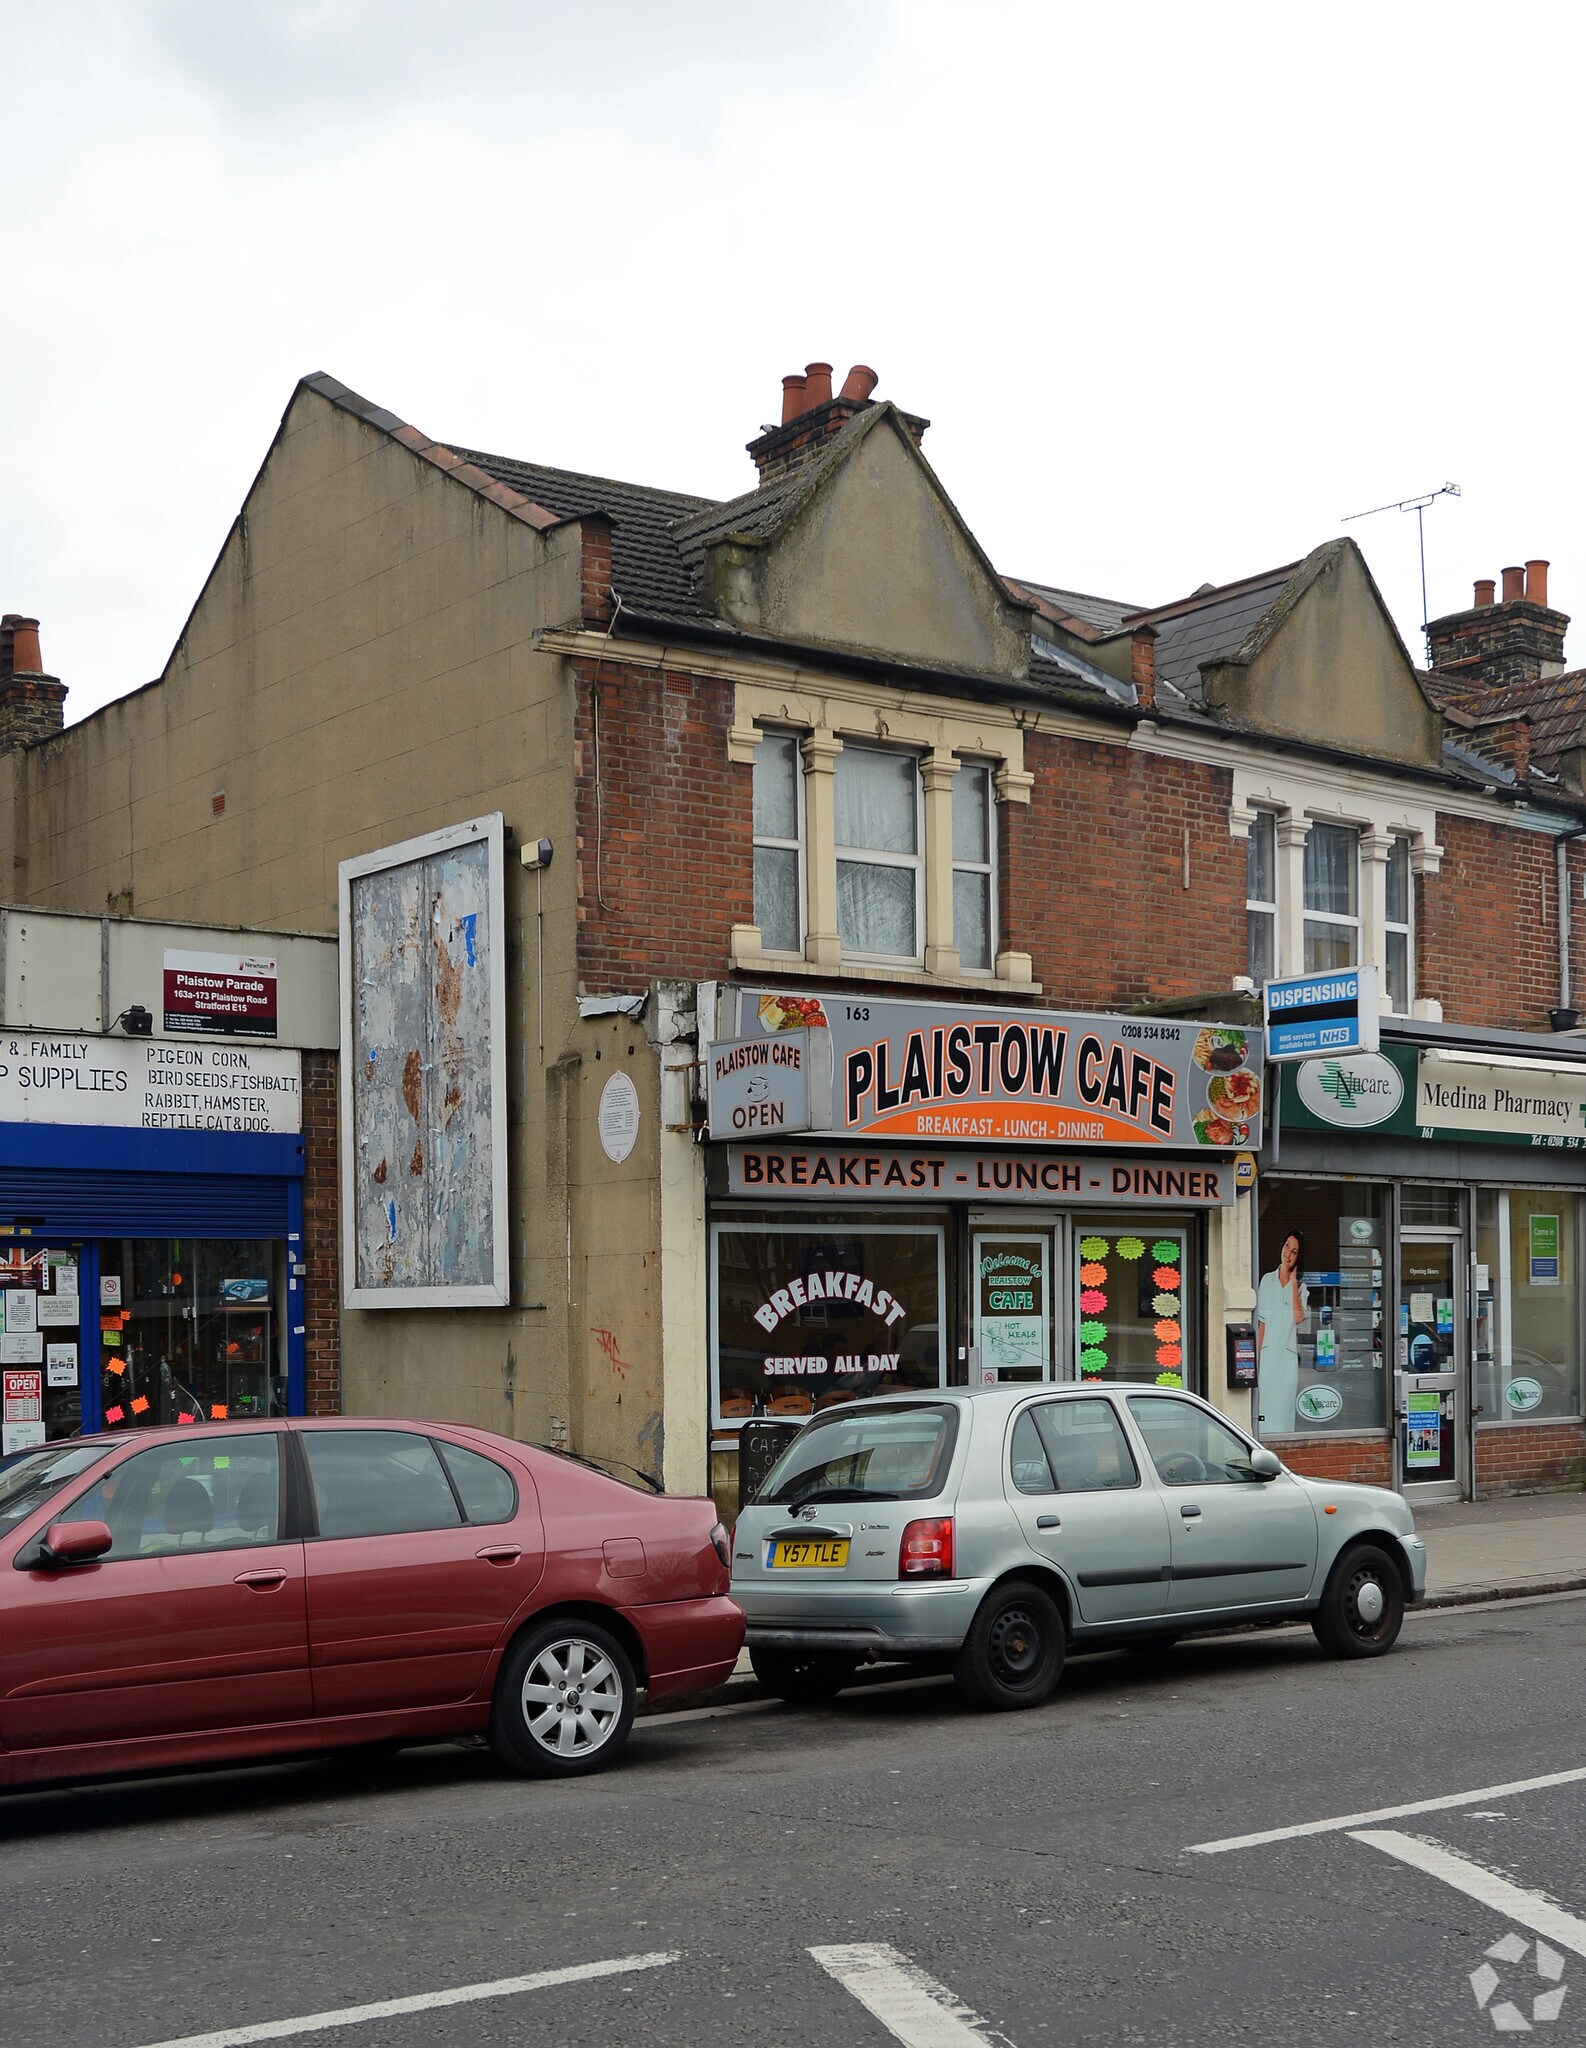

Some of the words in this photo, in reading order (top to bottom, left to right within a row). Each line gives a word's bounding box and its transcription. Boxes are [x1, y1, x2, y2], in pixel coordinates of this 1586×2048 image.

[176, 974, 224, 988] Plaistow
[226, 978, 264, 991] Parade
[173, 989, 210, 1000] 163a-173
[211, 992, 245, 1003] Plaistow
[246, 994, 268, 1005] Road
[1271, 980, 1357, 1007] DISPENSING
[195, 1001, 231, 1011] Stratford
[232, 1003, 248, 1012] E15
[846, 1006, 870, 1021] 163
[1121, 1025, 1142, 1037] 0208
[1144, 1026, 1159, 1039] 534
[1160, 1028, 1180, 1041] 8342
[1279, 1035, 1292, 1043] NHS
[1292, 1033, 1316, 1041] services
[1322, 1029, 1347, 1043] NHS
[9, 1041, 19, 1056] &
[31, 1041, 88, 1059] FAMILY
[1279, 1041, 1303, 1050] available
[146, 1048, 203, 1066] PIGEON
[212, 1051, 251, 1071] CORN,
[715, 1043, 769, 1080] PLAISTOW
[772, 1043, 801, 1070] CAFE
[18, 1066, 128, 1092] SUPPLIES
[148, 1069, 183, 1086] BIRD
[846, 1023, 1069, 1127] PLAISTOW
[1077, 1034, 1176, 1137] CAFE
[145, 1092, 202, 1111] RABBIT,
[204, 1095, 269, 1114] HAMSTER,
[1422, 1082, 1487, 1111] Medina
[1493, 1088, 1573, 1124] Pharmacy
[732, 1102, 785, 1129] OPEN
[917, 1115, 994, 1136] BREAKFAST
[1004, 1119, 1047, 1138] LUNCH
[1058, 1121, 1104, 1139] DINNER
[1421, 1127, 1435, 1139] 161
[743, 1153, 946, 1189] BREAKFAST
[976, 1160, 1081, 1192] LUNCH
[1111, 1167, 1220, 1199] DINNER
[1238, 1164, 1252, 1175] ADT
[980, 1252, 1031, 1279] Welcome
[1030, 1264, 1042, 1278] to
[988, 1275, 1033, 1286] PLAISTOW
[754, 1271, 906, 1333] BREAKFAST
[989, 1291, 1034, 1310] CAFE
[1004, 1322, 1021, 1330] HOT
[1008, 1331, 1037, 1339] MEALS
[764, 1357, 828, 1375] SERVED
[834, 1356, 863, 1373] ALL
[868, 1354, 900, 1371] DAY
[9, 1379, 37, 1390] OPEN
[783, 1544, 810, 1563] Y57
[814, 1543, 842, 1563] TLE
